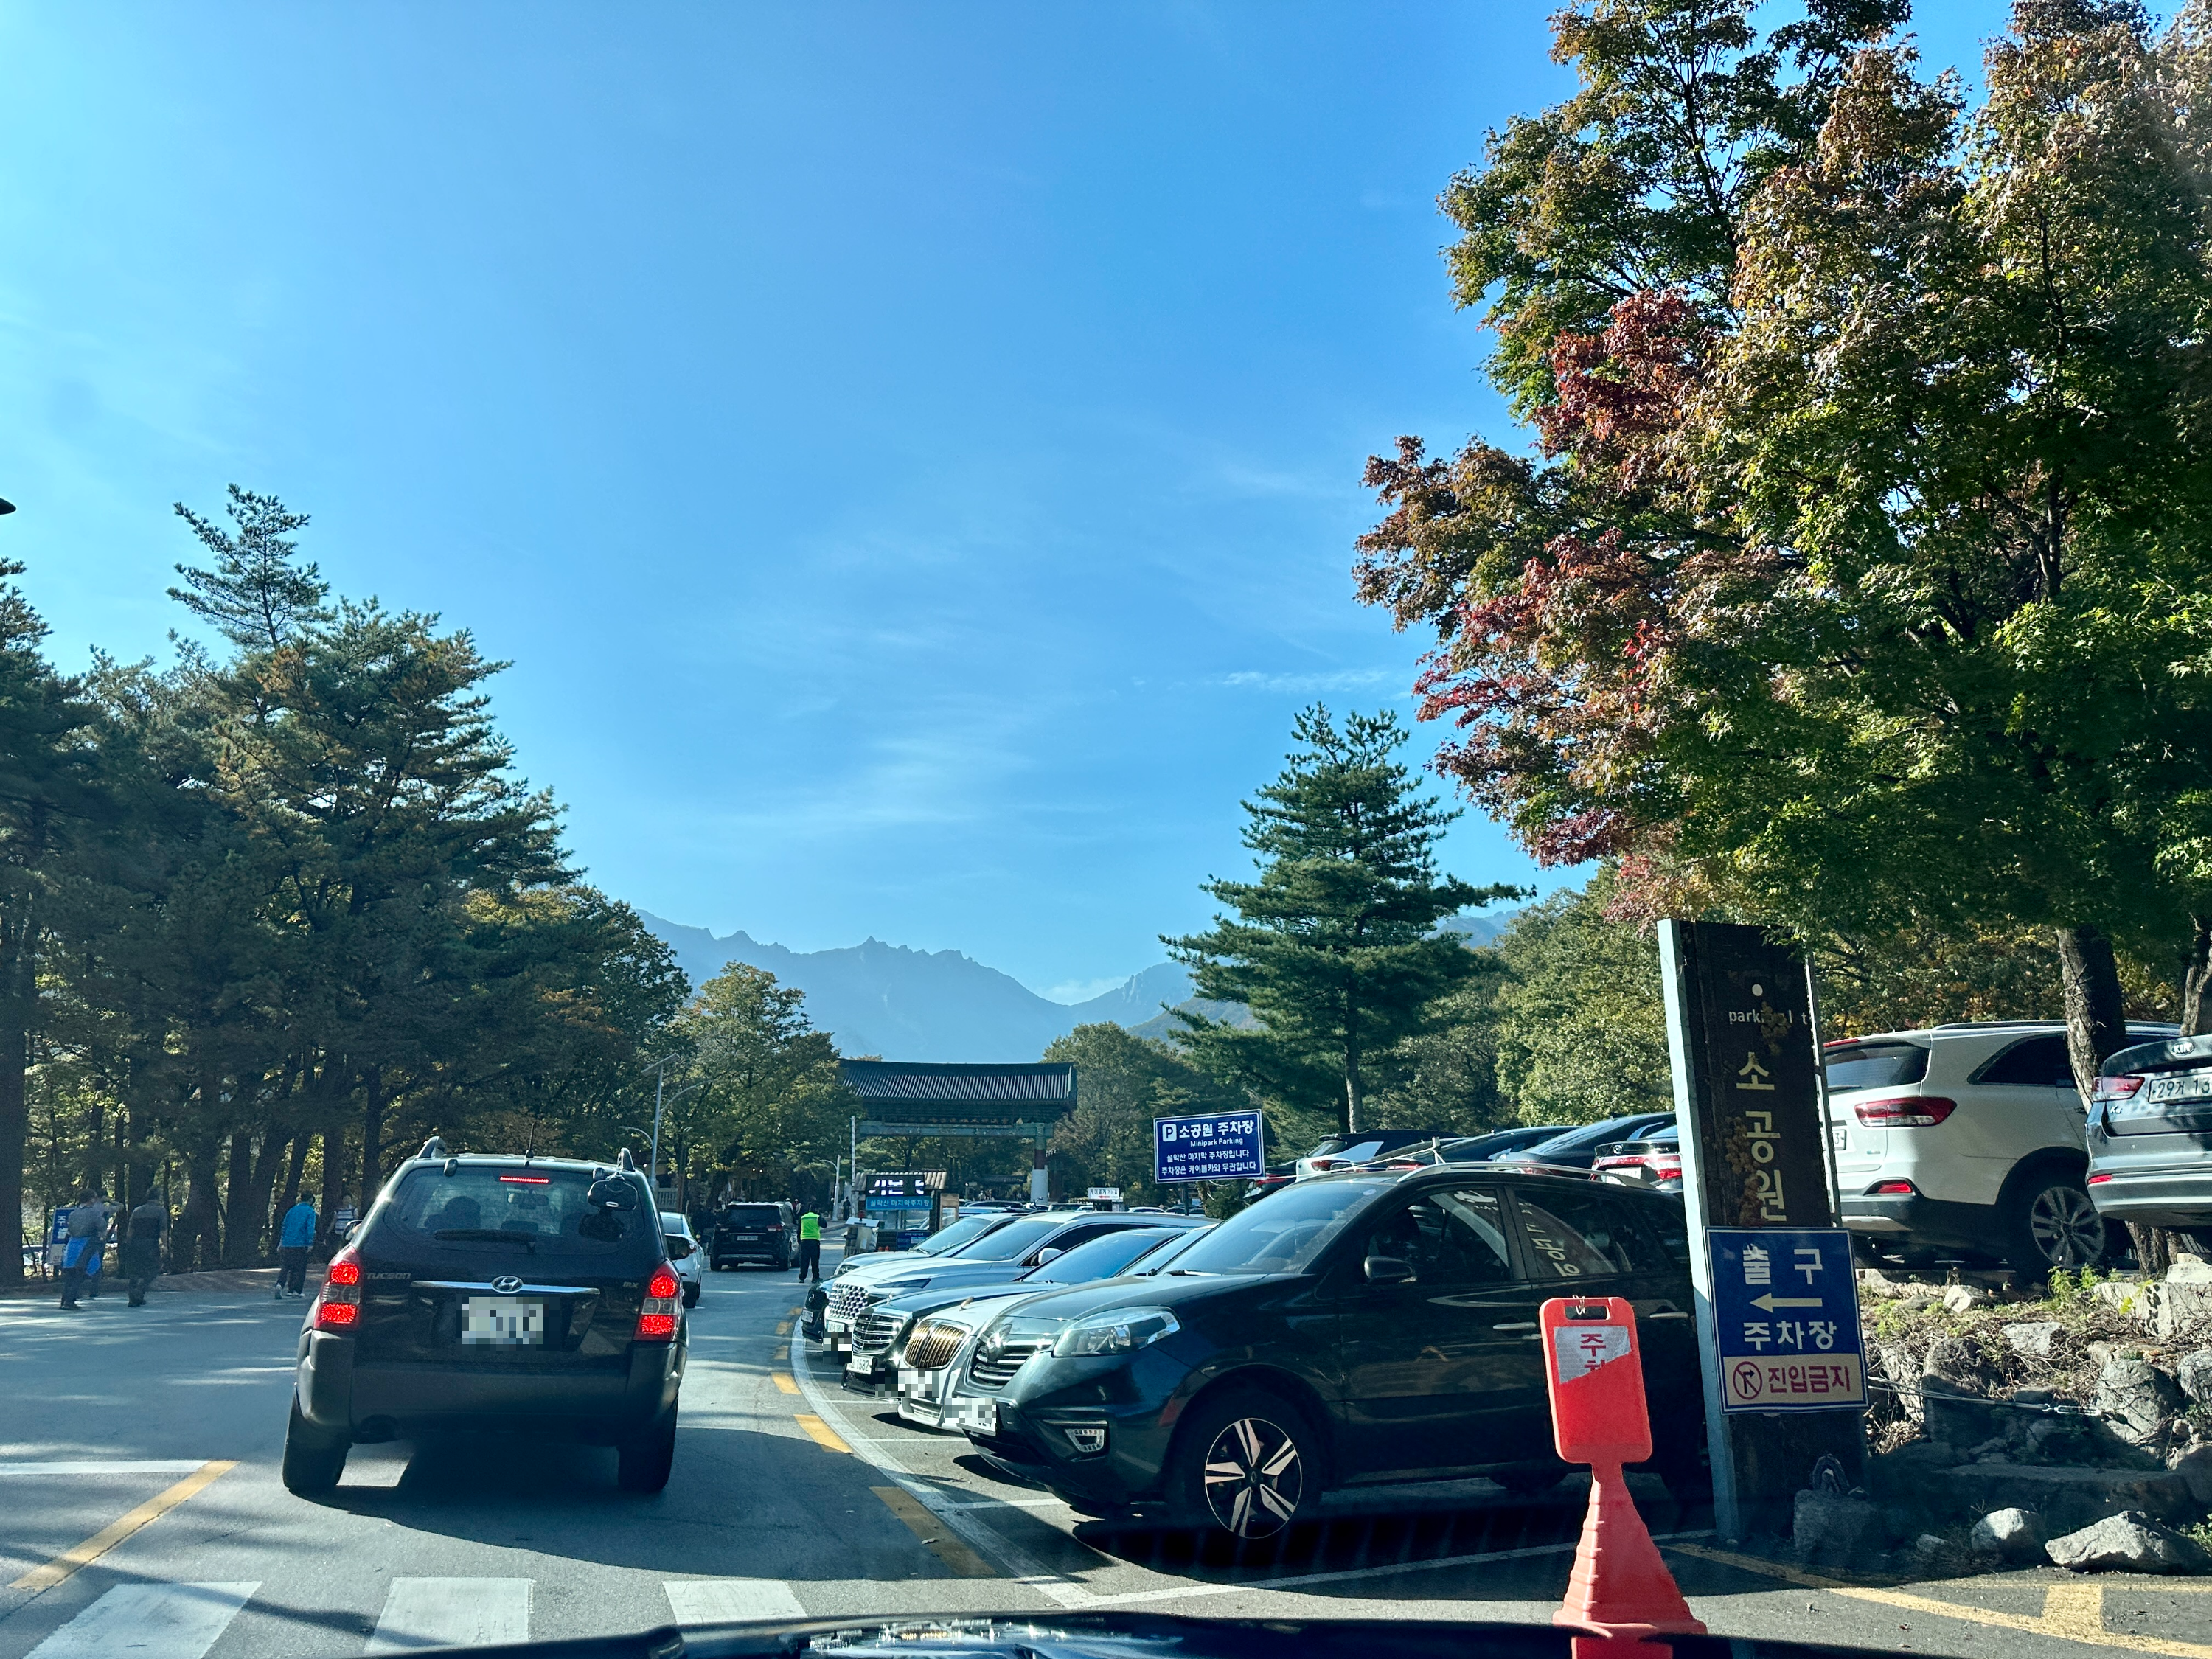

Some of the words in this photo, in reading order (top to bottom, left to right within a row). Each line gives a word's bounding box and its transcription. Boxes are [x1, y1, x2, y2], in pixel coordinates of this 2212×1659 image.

[1728, 1009, 1785, 1026] park
[2172, 1041, 2192, 1054] KIA
[1179, 1123, 1213, 1138] 소공원
[1217, 1120, 1254, 1135] 주차장
[1736, 1052, 1787, 1222] 소공원
[1166, 1153, 1186, 1163] 설악산
[1188, 1152, 1207, 1161] 마지막
[1208, 1150, 1249, 1160] 주차장입니다
[1161, 1165, 1186, 1176] 주차장은
[1222, 1161, 1256, 1172] 무관합니다
[1743, 1321, 1838, 1351] 주차장
[1768, 1366, 1851, 1394] 진입금지
